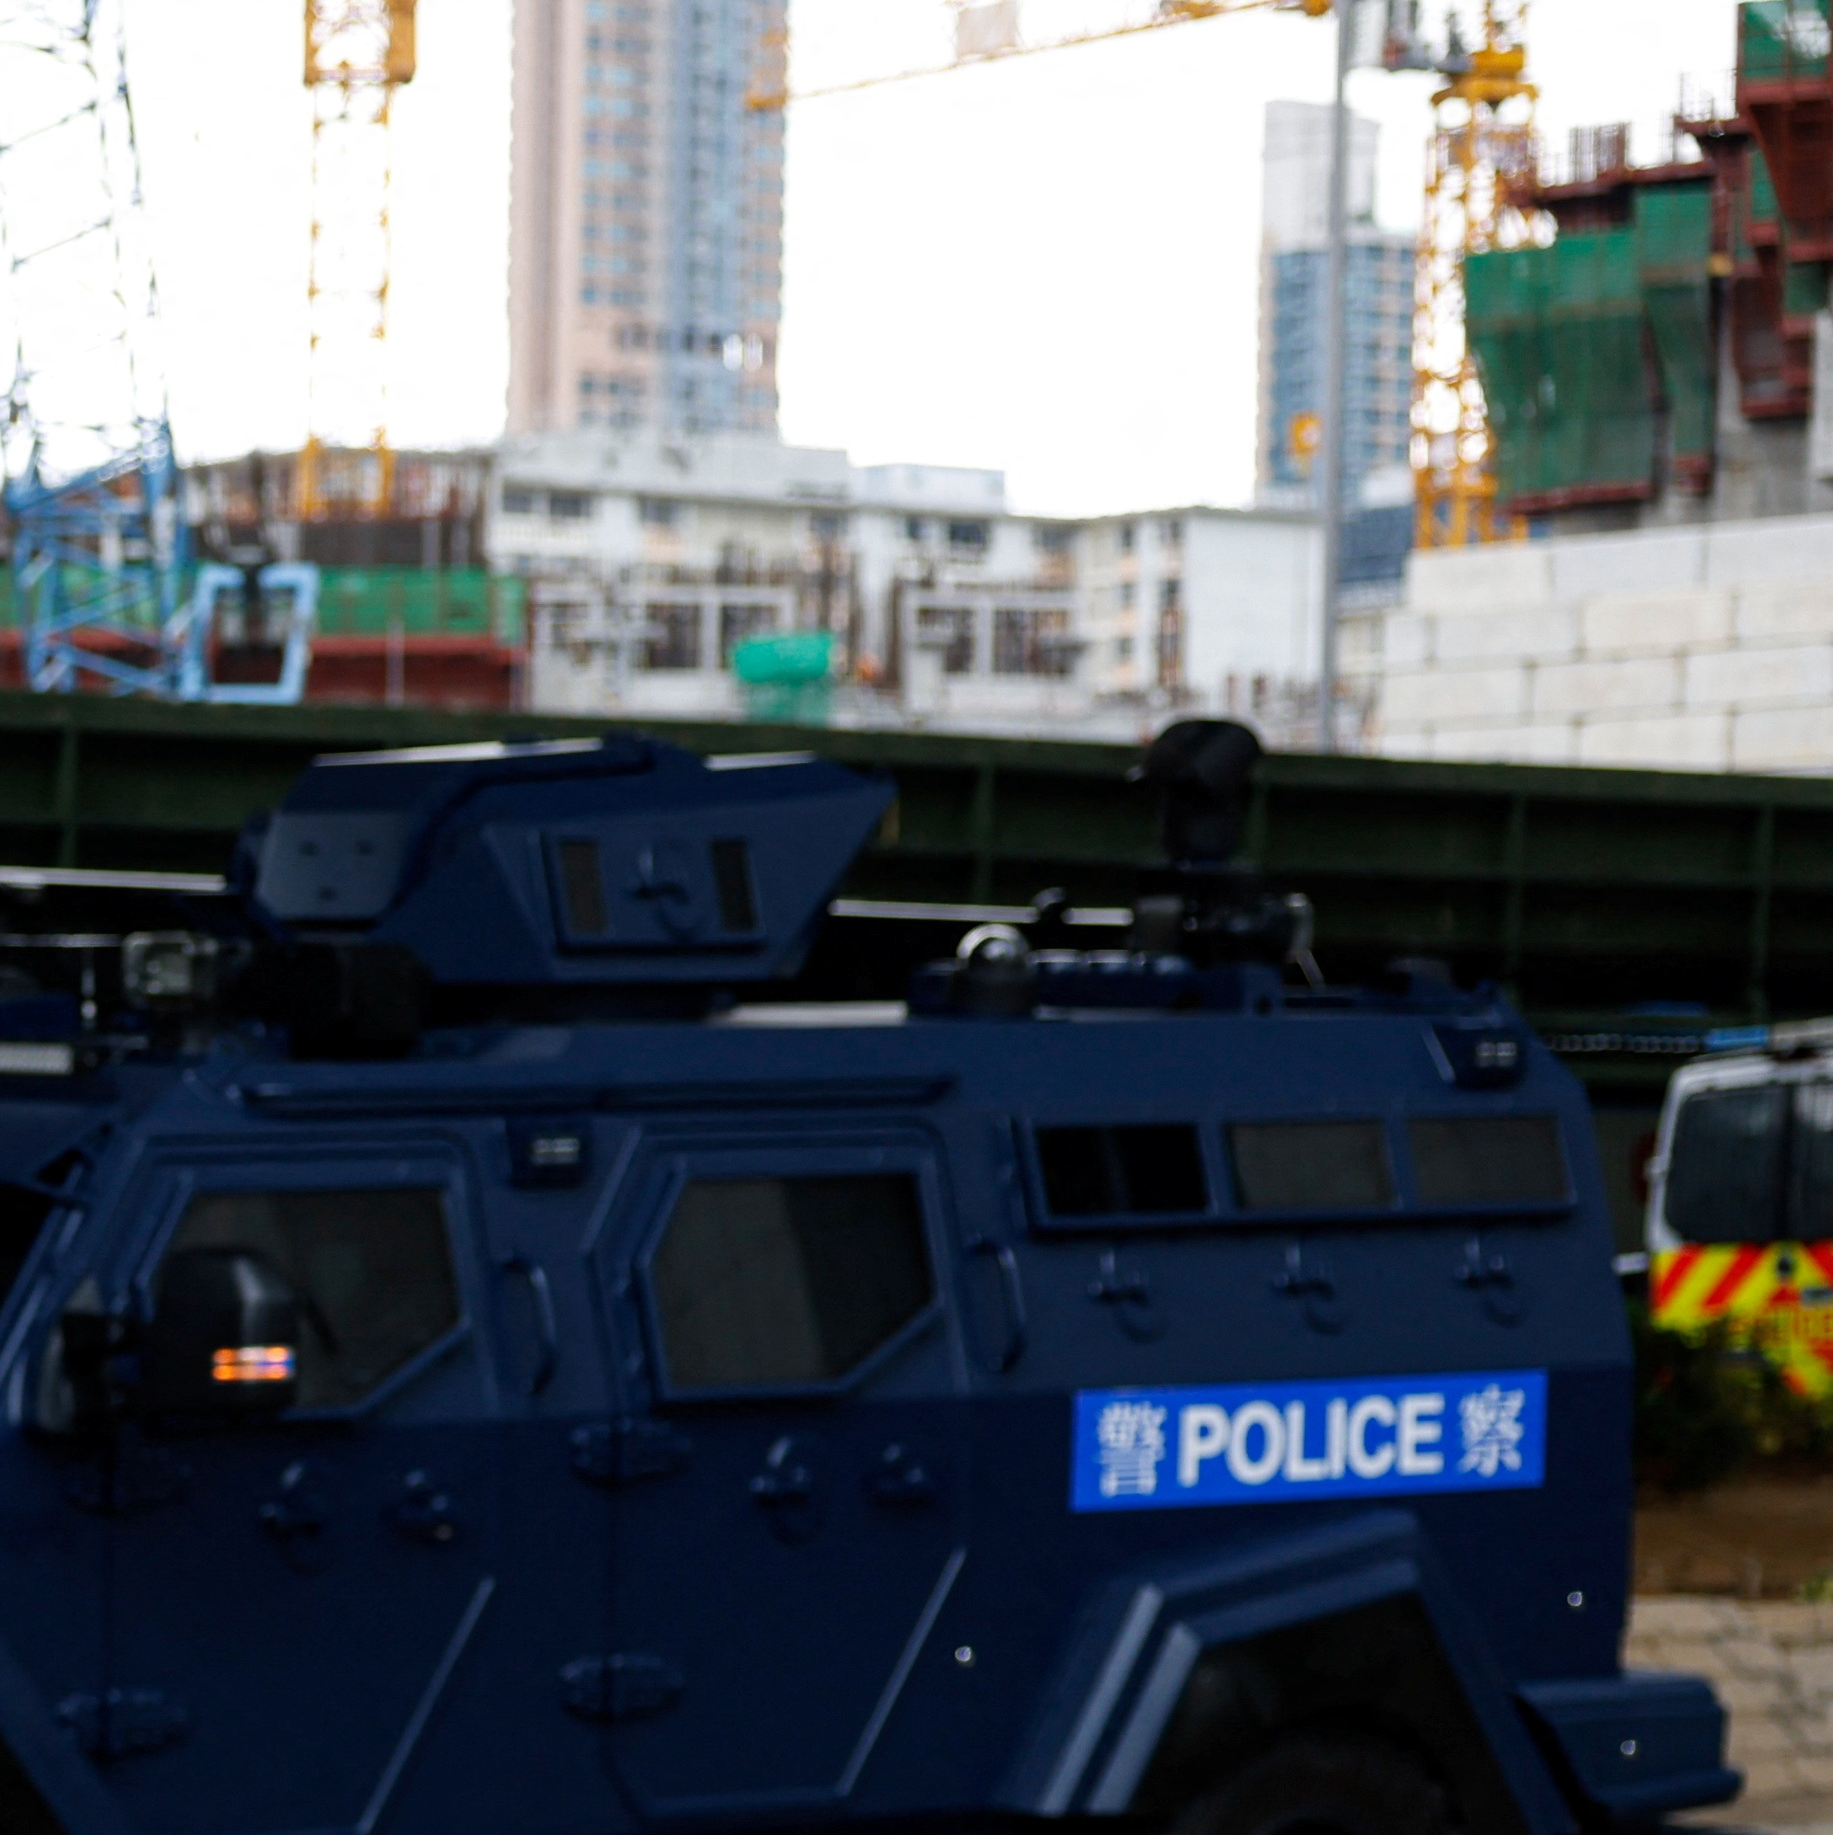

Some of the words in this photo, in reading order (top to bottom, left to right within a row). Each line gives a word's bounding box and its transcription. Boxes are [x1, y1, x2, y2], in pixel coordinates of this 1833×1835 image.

[1096, 1401, 1167, 1497] 警
[1176, 1391, 1446, 1488] POLICE
[1458, 1383, 1526, 1478] 察
